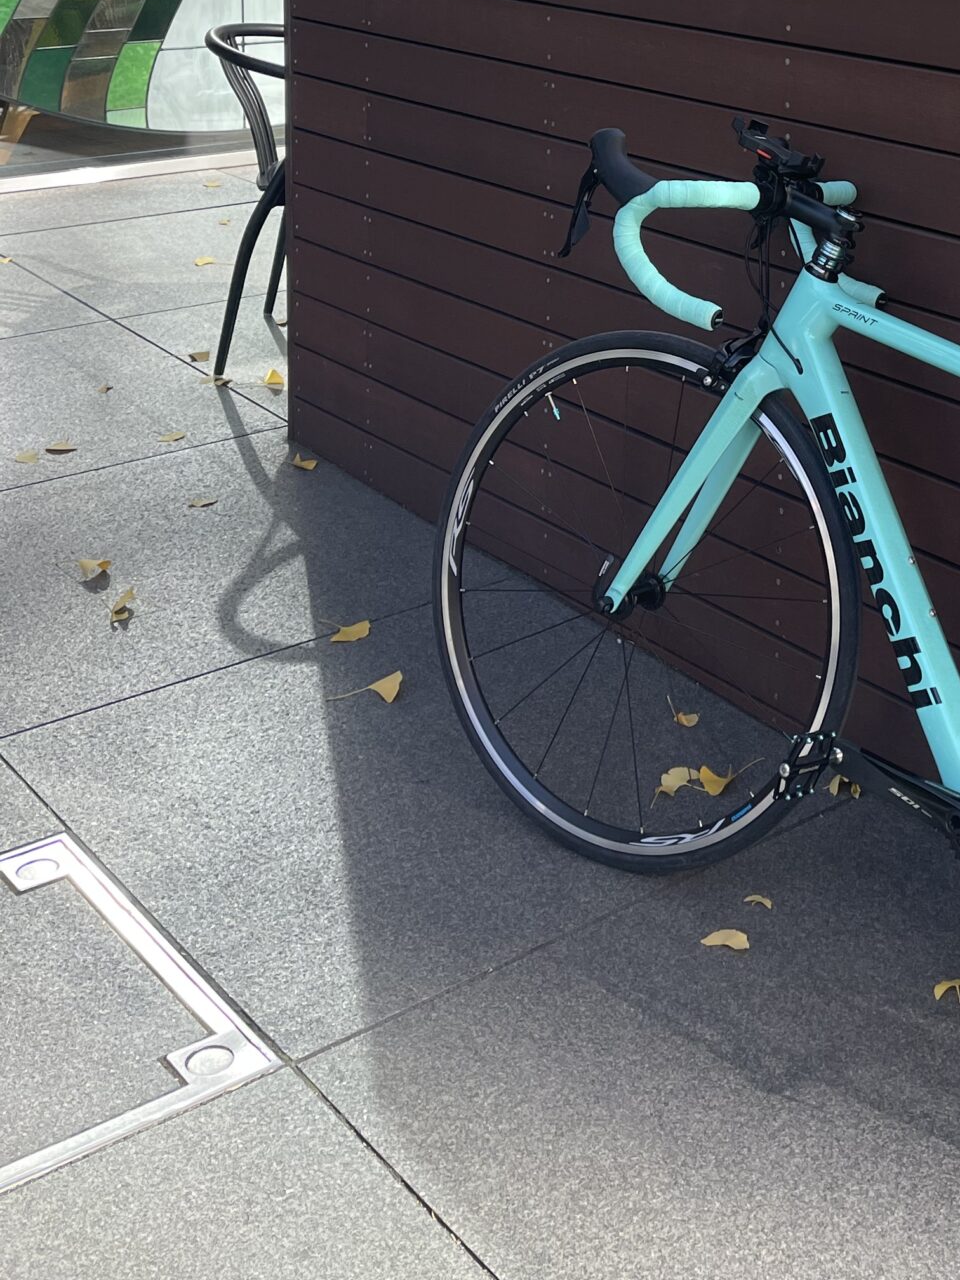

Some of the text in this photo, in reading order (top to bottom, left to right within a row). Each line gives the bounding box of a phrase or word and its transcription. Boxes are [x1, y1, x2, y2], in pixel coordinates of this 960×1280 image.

[832, 303, 878, 326] SPRINT
[494, 379, 526, 413] PIRELLI
[810, 413, 942, 710] Bianchi
